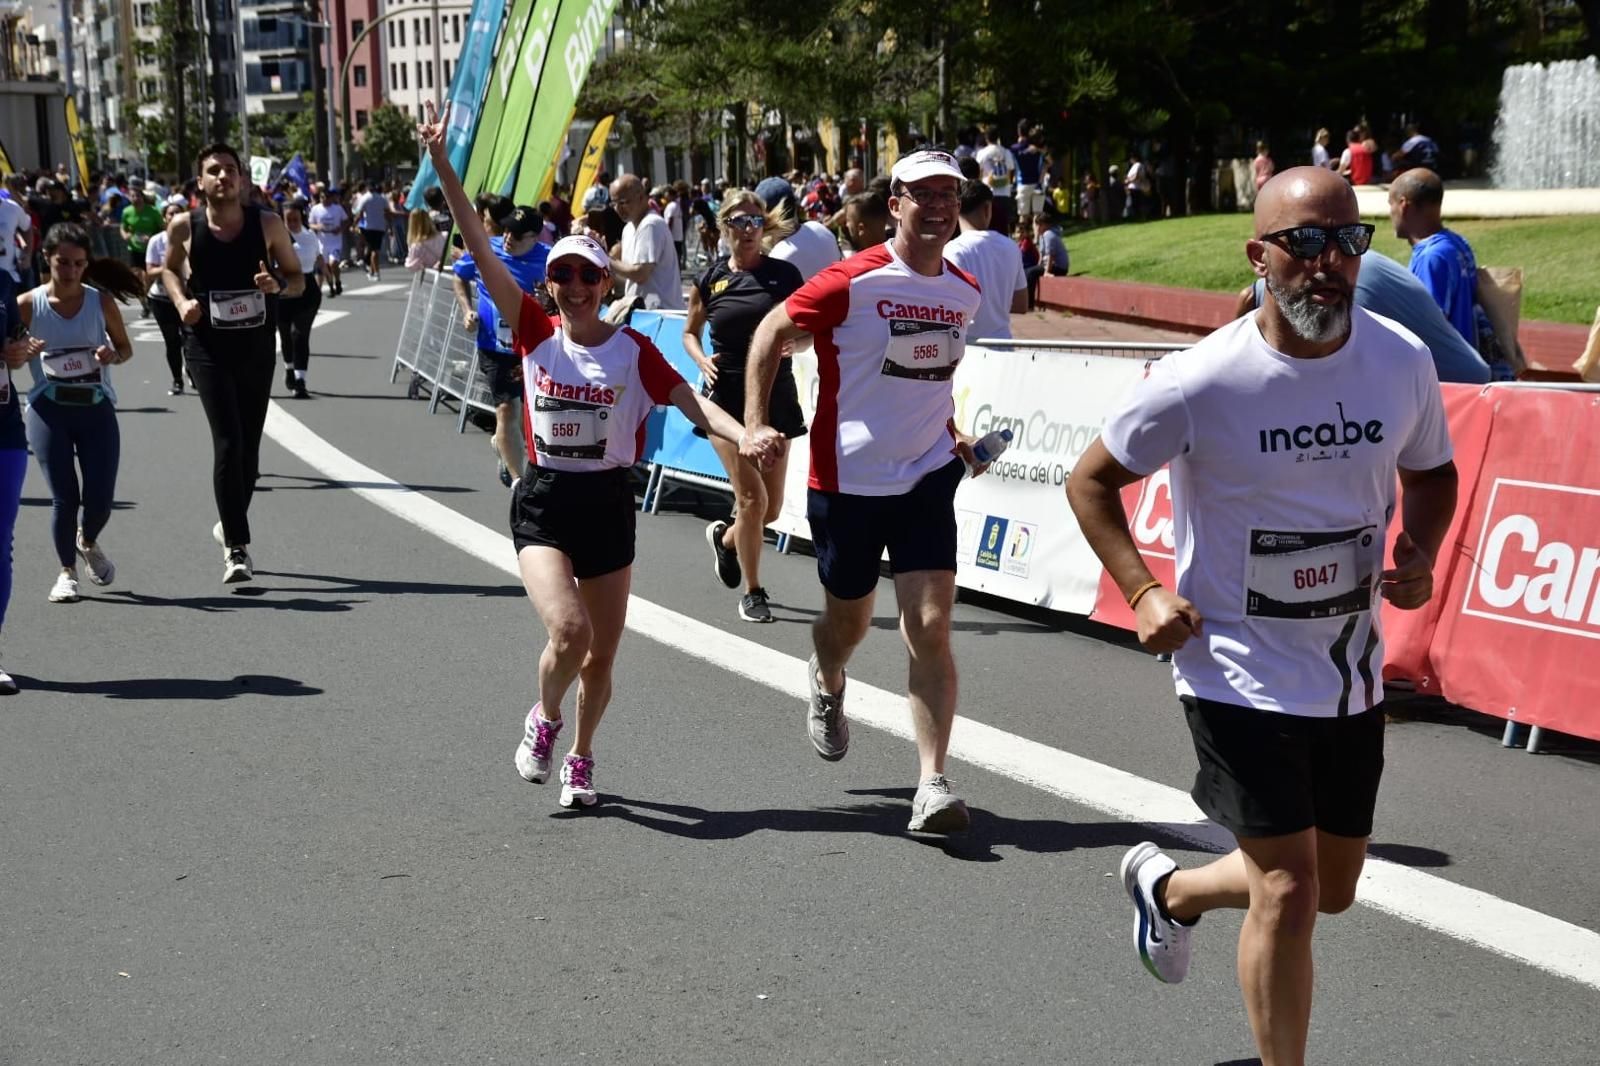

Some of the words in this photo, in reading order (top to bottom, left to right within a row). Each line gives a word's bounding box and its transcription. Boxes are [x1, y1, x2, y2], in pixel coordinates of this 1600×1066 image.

[912, 344, 939, 360] 5585
[552, 423, 581, 437] 5587
[1026, 409, 1106, 456] Canar
[1030, 461, 1051, 484] del
[1294, 563, 1338, 590] 6047
